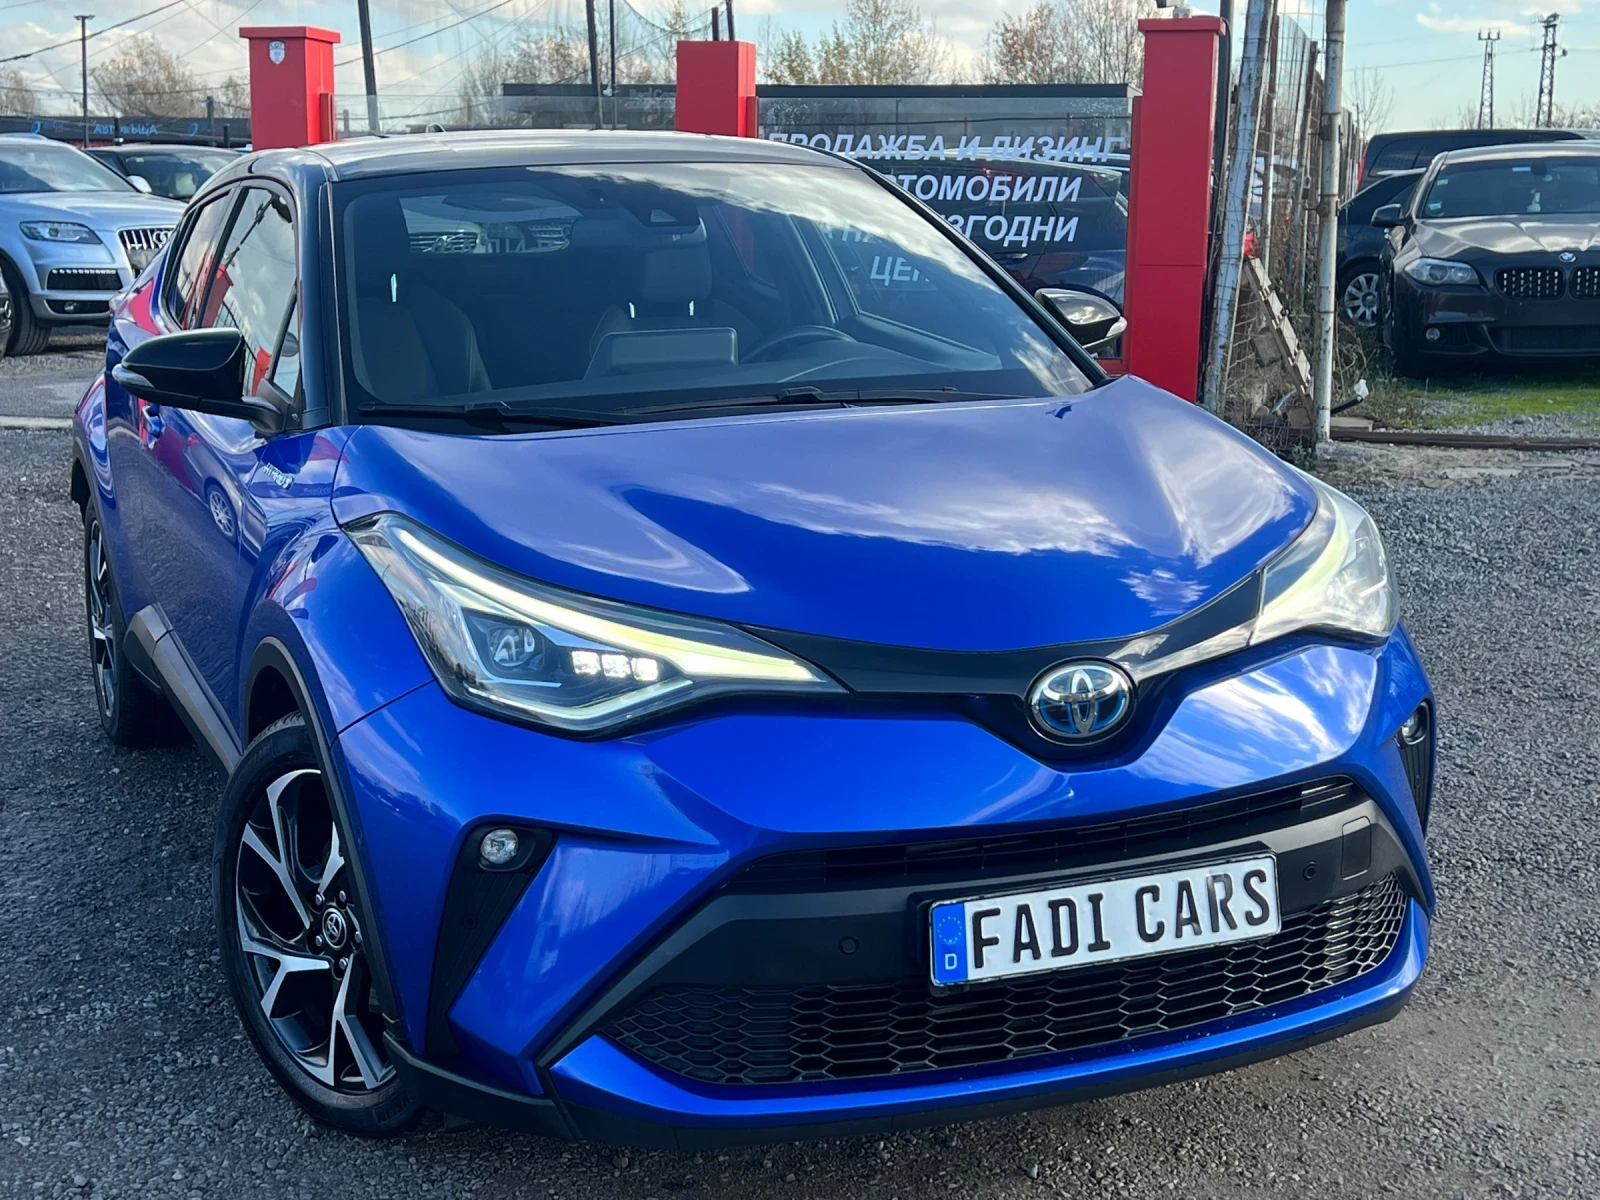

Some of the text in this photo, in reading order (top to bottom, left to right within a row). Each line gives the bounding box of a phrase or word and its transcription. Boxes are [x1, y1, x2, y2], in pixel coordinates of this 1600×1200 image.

[769, 134, 1125, 163] ОДАЖБА И ЛИЗИНГ
[884, 174, 1083, 203] ТОМОБИЛИ
[936, 214, 1080, 247] ЗГОДНИ
[971, 868, 1271, 969] FADI CARS
[944, 953, 958, 970] D
